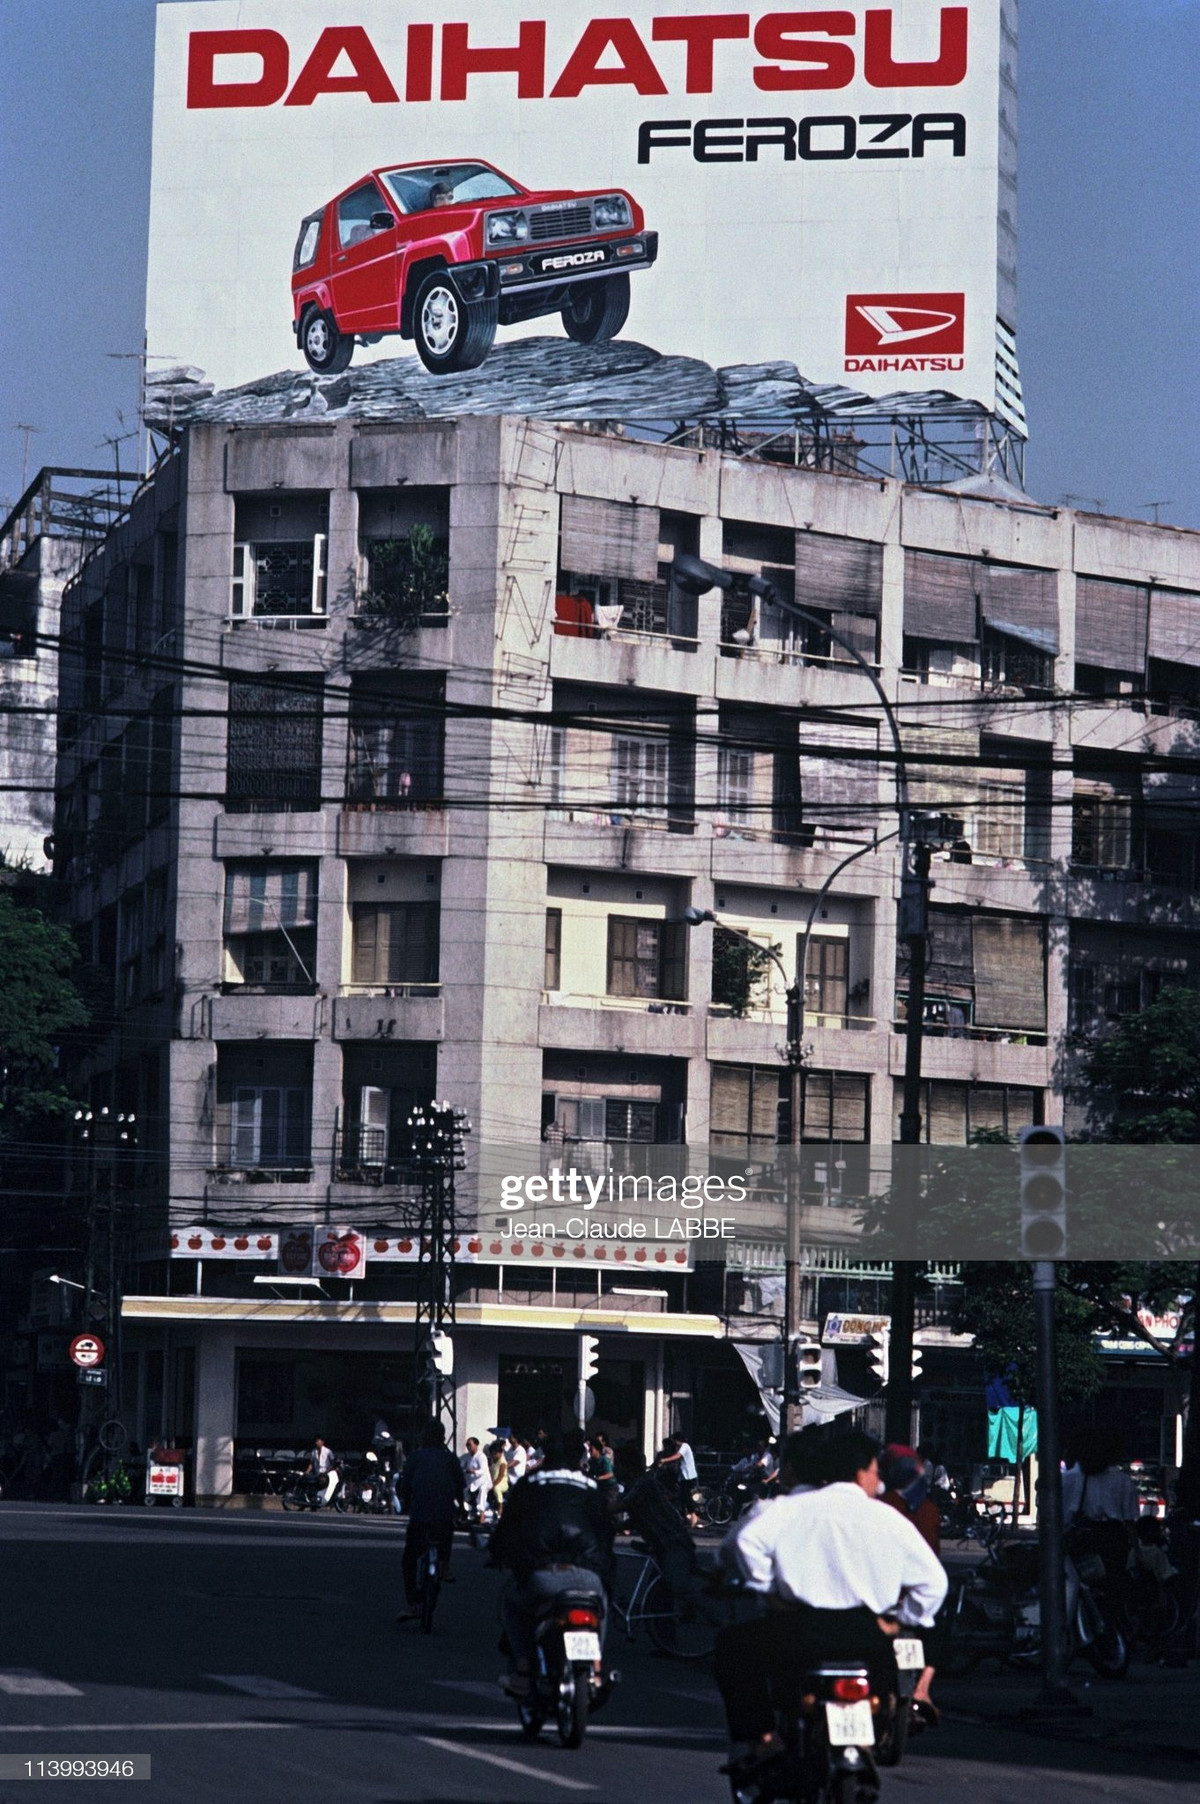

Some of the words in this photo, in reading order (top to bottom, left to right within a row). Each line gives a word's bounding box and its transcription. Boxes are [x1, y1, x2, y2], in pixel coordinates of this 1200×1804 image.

[186, 6, 968, 109] DAIHATSU
[637, 113, 966, 164] FEROZA
[541, 249, 605, 271] FEROZA
[844, 357, 964, 372] DAIHATSU
